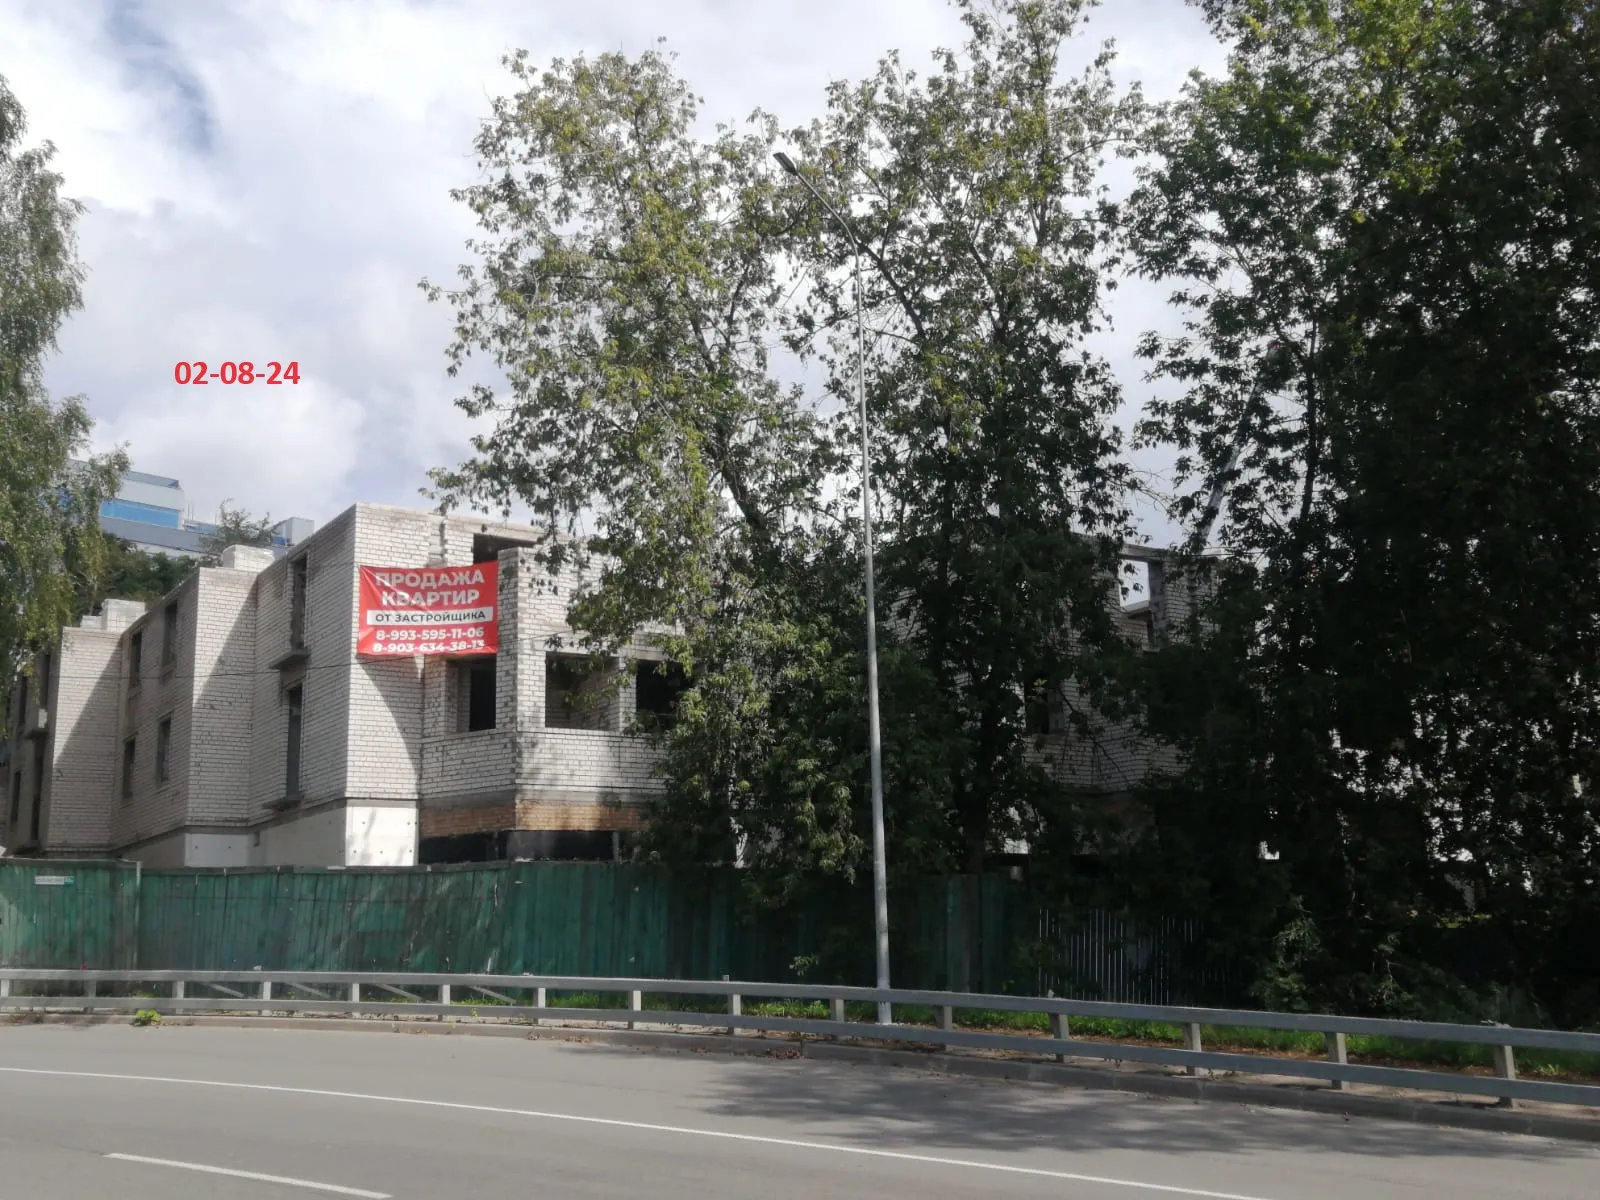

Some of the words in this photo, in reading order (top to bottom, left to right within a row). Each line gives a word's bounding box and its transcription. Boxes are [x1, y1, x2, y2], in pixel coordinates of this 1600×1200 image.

[375, 569, 485, 590] ПРОДАЖА
[381, 589, 480, 606] КВАРТИР
[375, 614, 390, 622] ОТ
[395, 611, 486, 623] ЗАСТРОЙЩИКА
[376, 627, 484, 641] 8-993-595-11-06
